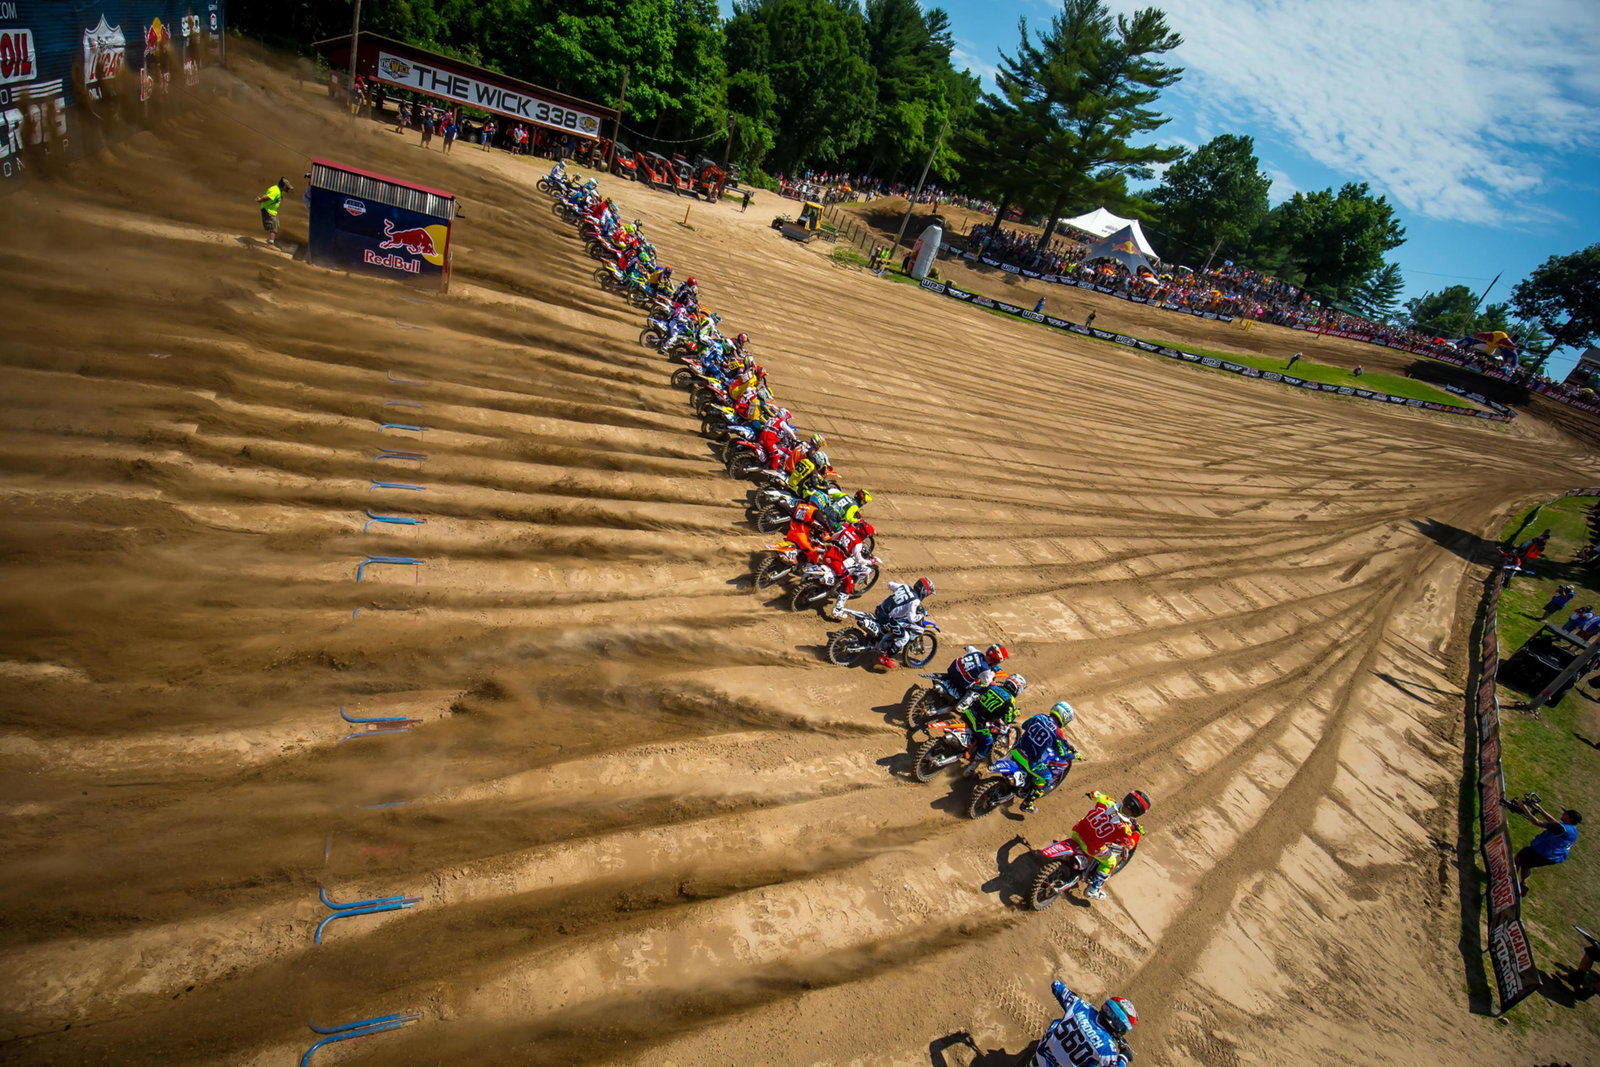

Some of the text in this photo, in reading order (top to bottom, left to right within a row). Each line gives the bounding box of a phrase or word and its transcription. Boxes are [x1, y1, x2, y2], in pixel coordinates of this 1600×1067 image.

[413, 64, 578, 130] THE WICK 338
[364, 248, 420, 273] Red Bull
[947, 287, 970, 299] FLY
[998, 302, 1021, 314] FLY
[1028, 722, 1050, 746] 48
[1086, 806, 1115, 838] 139
[1508, 923, 1531, 970] LUCAS OIL
[1054, 1017, 1093, 1064] 560
[1075, 1010, 1105, 1049] MURDOCH
